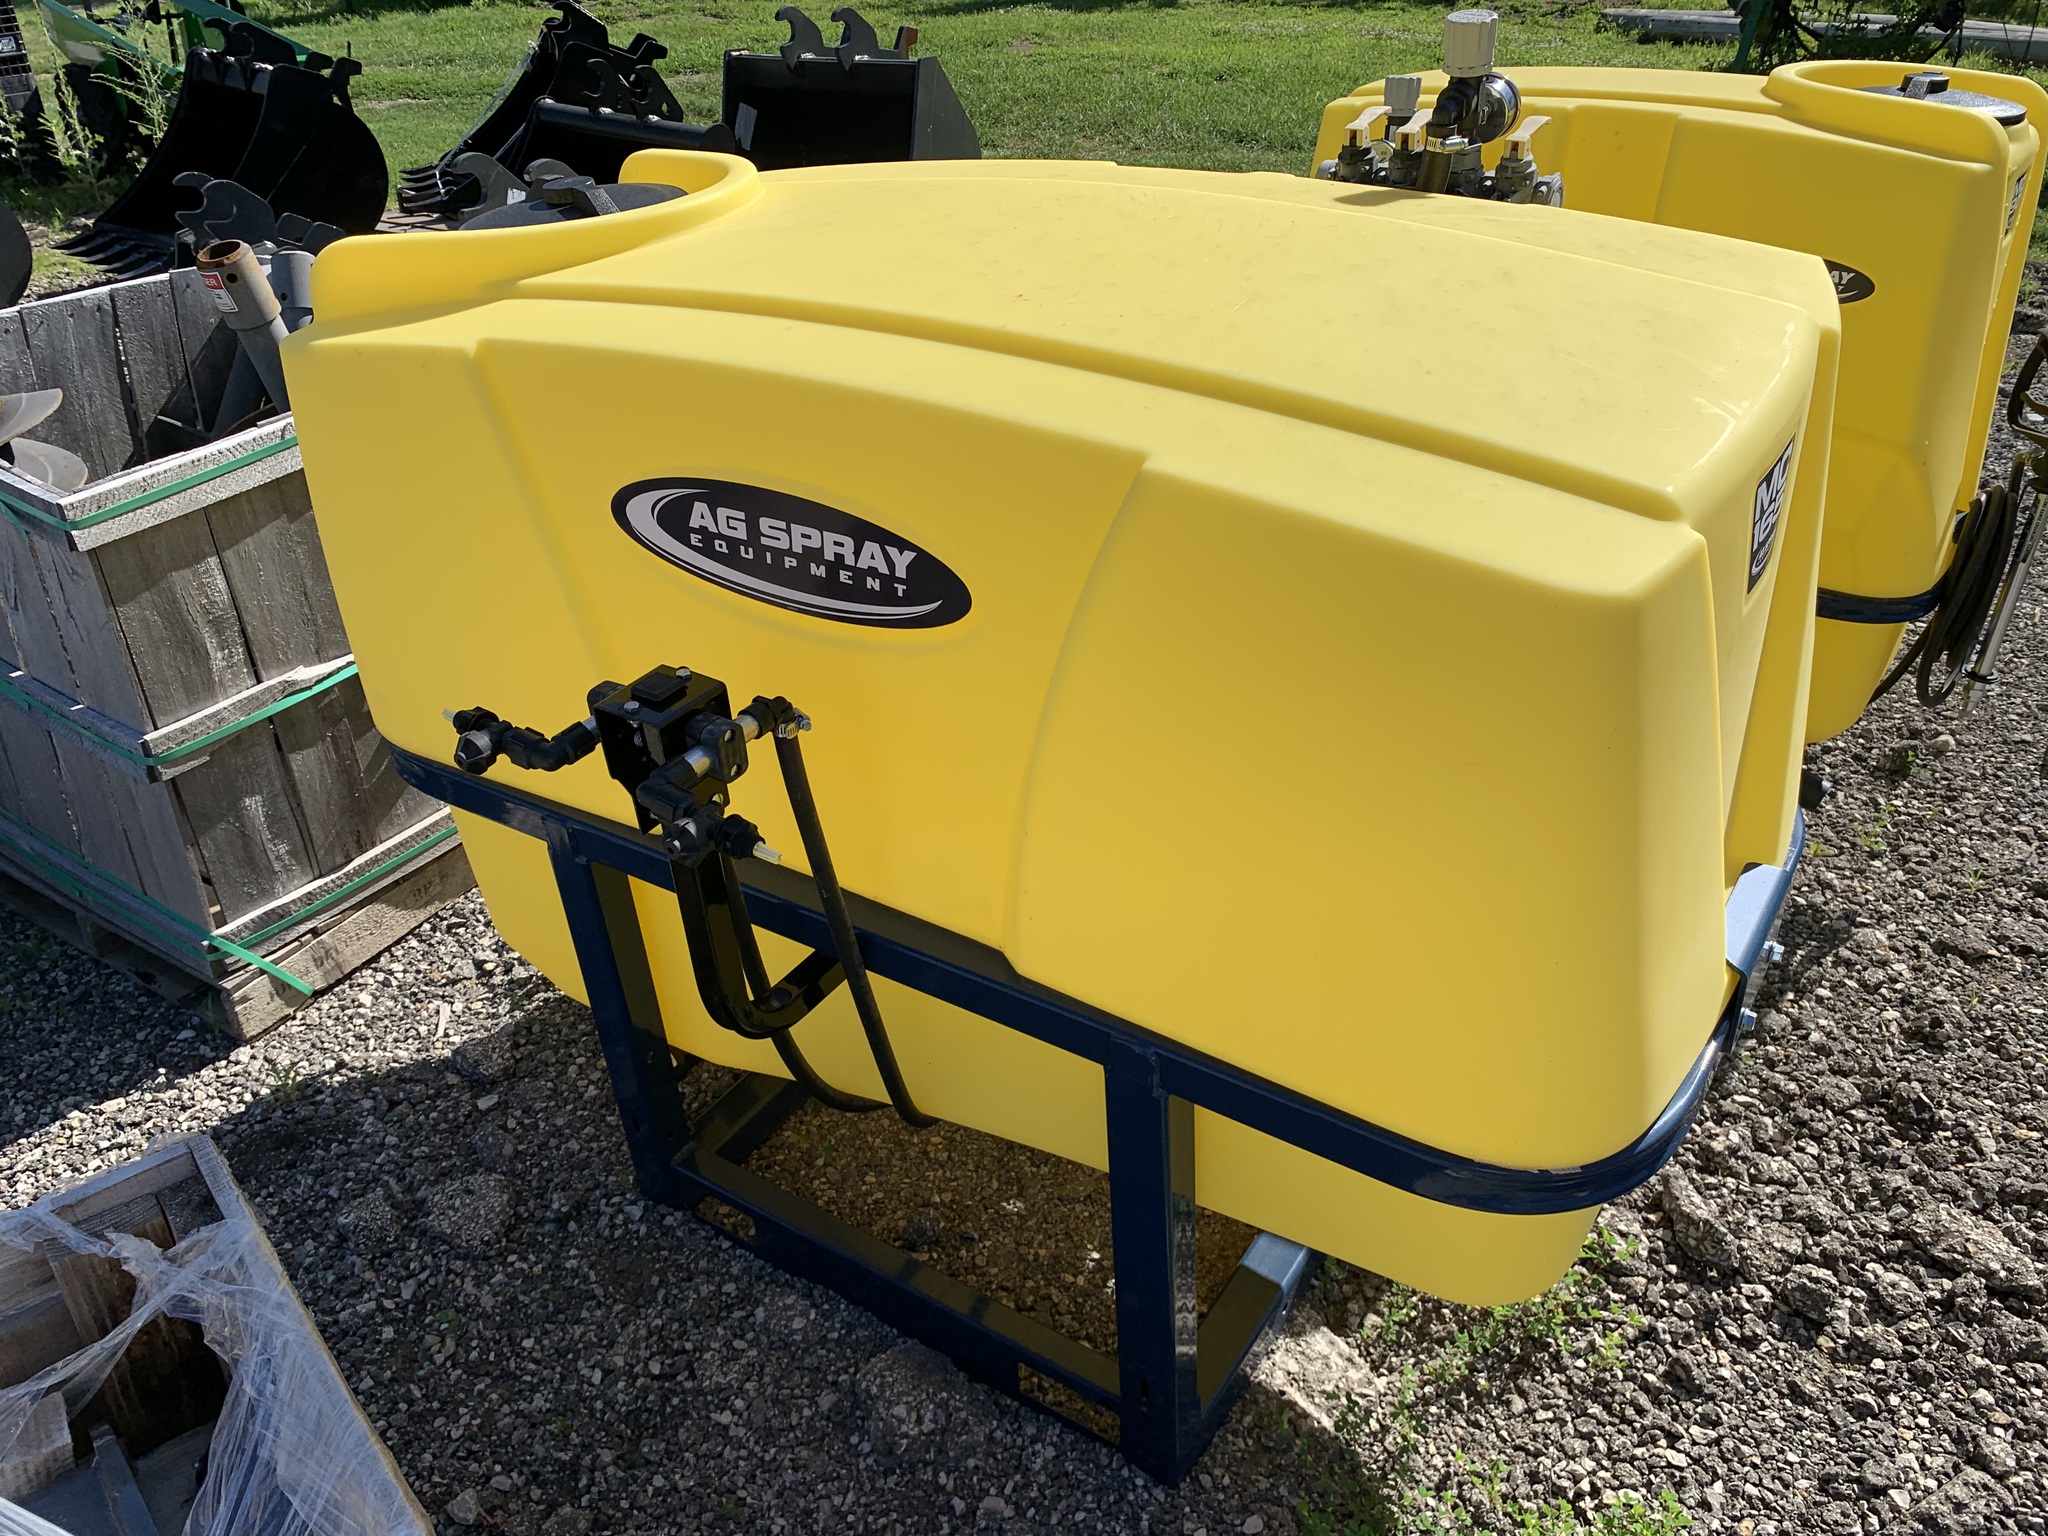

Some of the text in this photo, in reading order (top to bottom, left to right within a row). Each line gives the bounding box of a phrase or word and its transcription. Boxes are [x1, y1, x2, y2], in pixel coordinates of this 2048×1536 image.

[689, 501, 917, 579] AG SPRAY
[690, 533, 907, 597] EQUIPMENT
